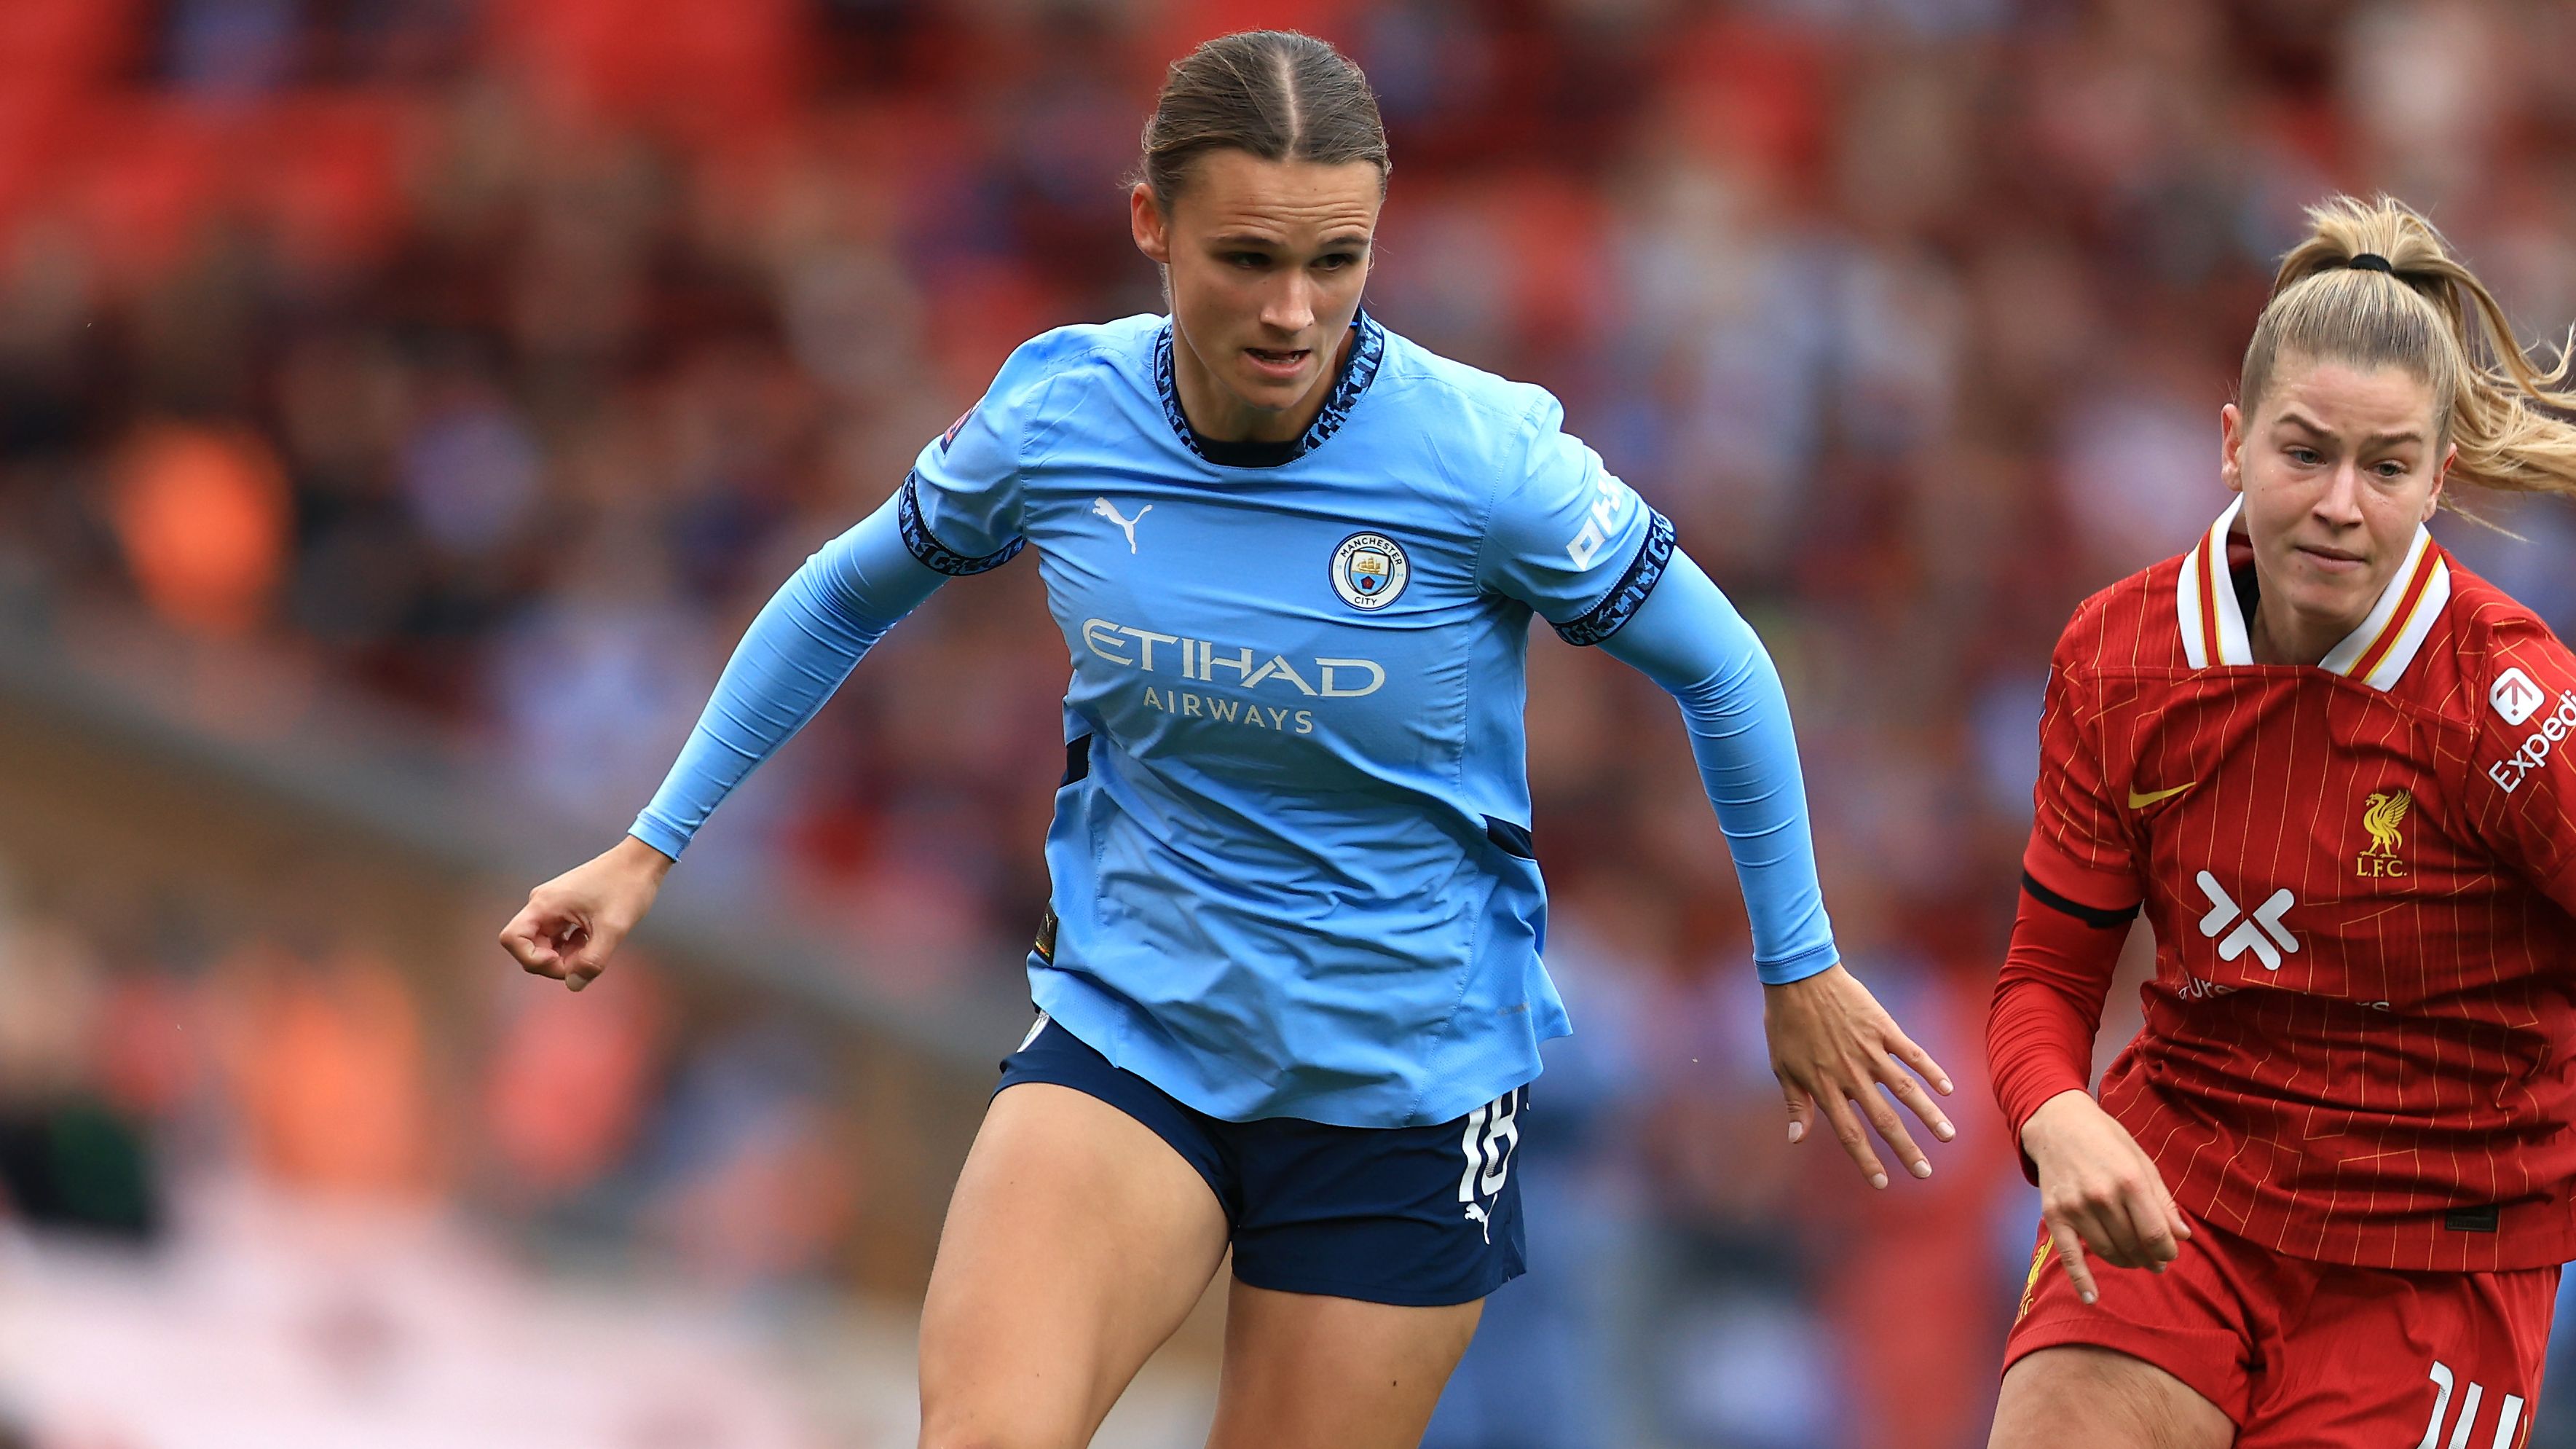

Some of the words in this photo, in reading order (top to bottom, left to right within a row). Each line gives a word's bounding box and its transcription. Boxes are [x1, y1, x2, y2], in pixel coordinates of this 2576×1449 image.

[1340, 538, 1403, 565] MANCHESTER
[1354, 597, 1377, 605] CITY
[1082, 618, 1385, 697] ETIHAD
[1143, 686, 1313, 734] AIRWAYS
[2356, 857, 2407, 878] L.F.C.
[1459, 1087, 1519, 1203] 18
